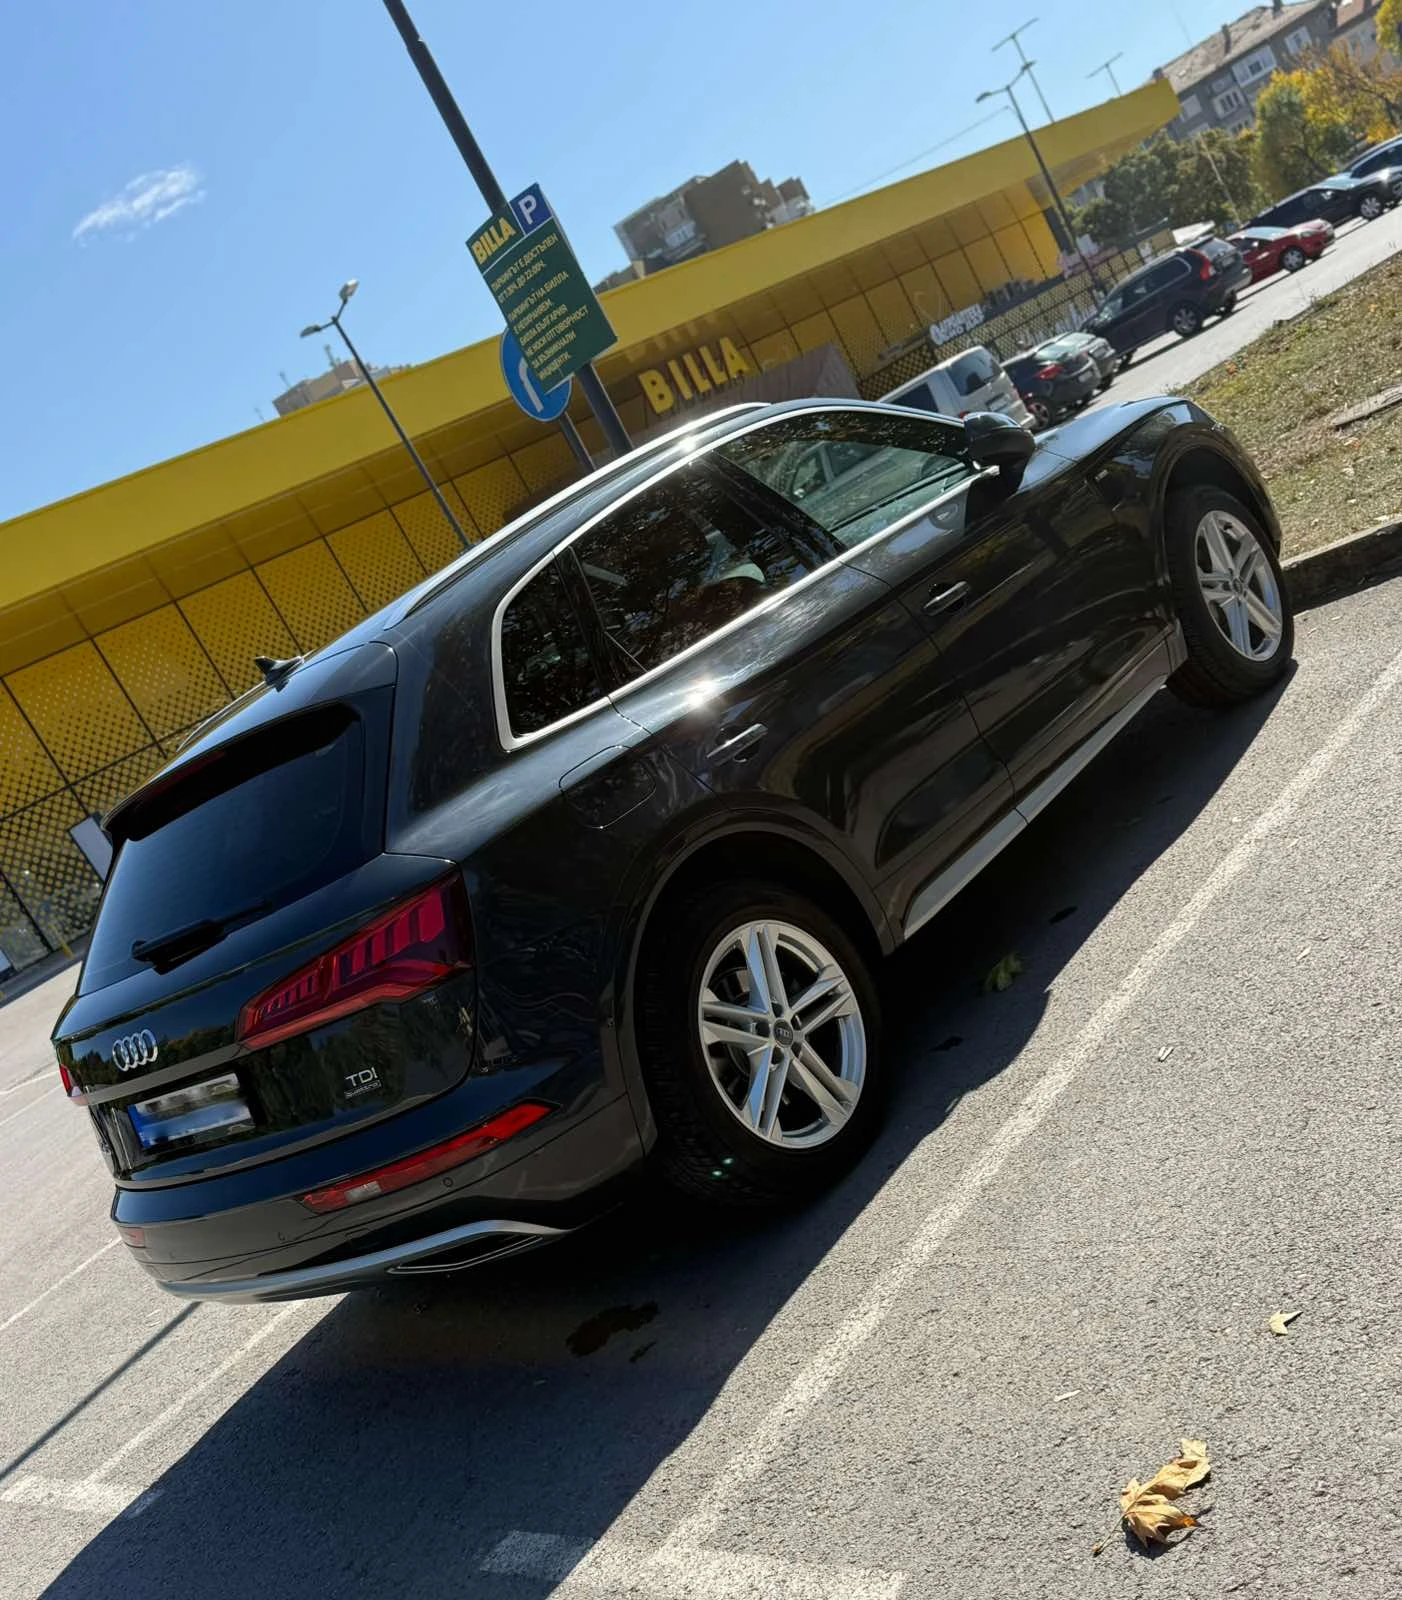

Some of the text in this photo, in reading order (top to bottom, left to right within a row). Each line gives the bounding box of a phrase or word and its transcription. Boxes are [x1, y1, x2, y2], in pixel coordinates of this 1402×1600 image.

[518, 195, 537, 225] P
[471, 217, 516, 265] BILLA
[638, 336, 753, 414] BILLA
[345, 1066, 378, 1087] TDI
